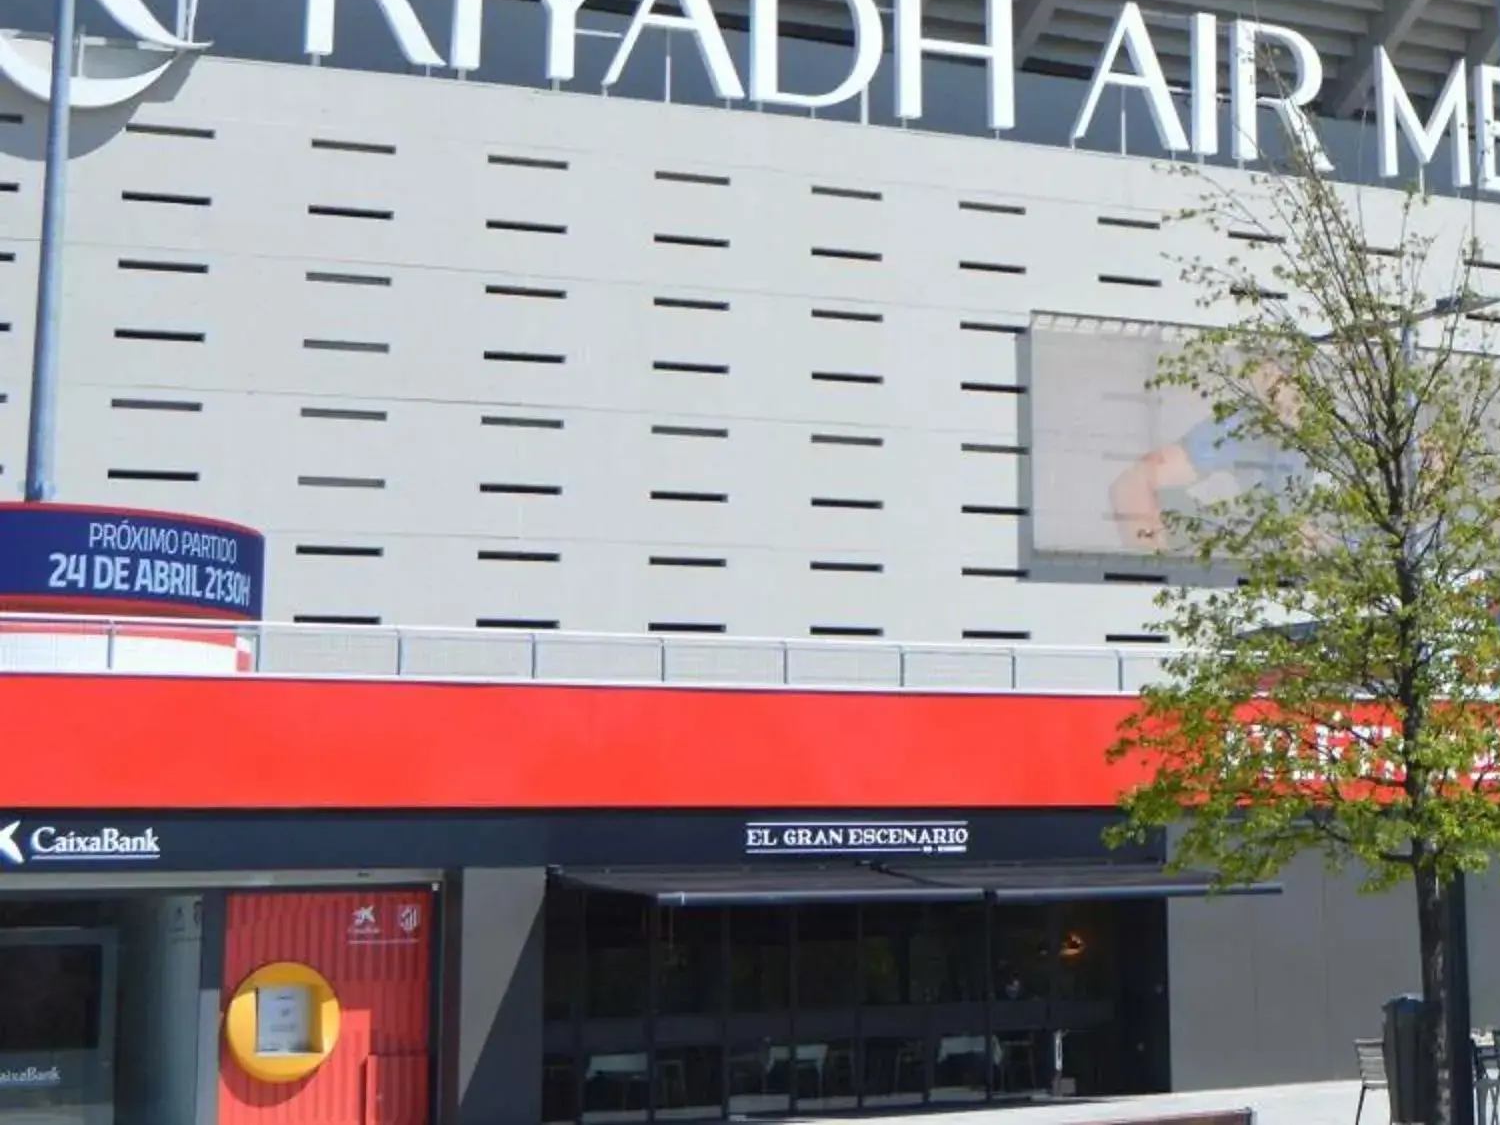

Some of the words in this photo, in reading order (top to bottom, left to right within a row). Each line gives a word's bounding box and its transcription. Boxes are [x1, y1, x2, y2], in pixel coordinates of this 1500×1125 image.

[1071, 1, 1336, 172] AIR
[88, 518, 179, 555] PRÓXIMO
[181, 530, 238, 565] PARTIDO
[49, 552, 87, 589] 24
[93, 554, 131, 591] DE
[133, 558, 203, 598] ABRIL
[30, 826, 161, 853] CaixaBank
[746, 829, 777, 846] EL
[783, 828, 844, 846] GRAN
[848, 827, 969, 845] ESCENARIO
